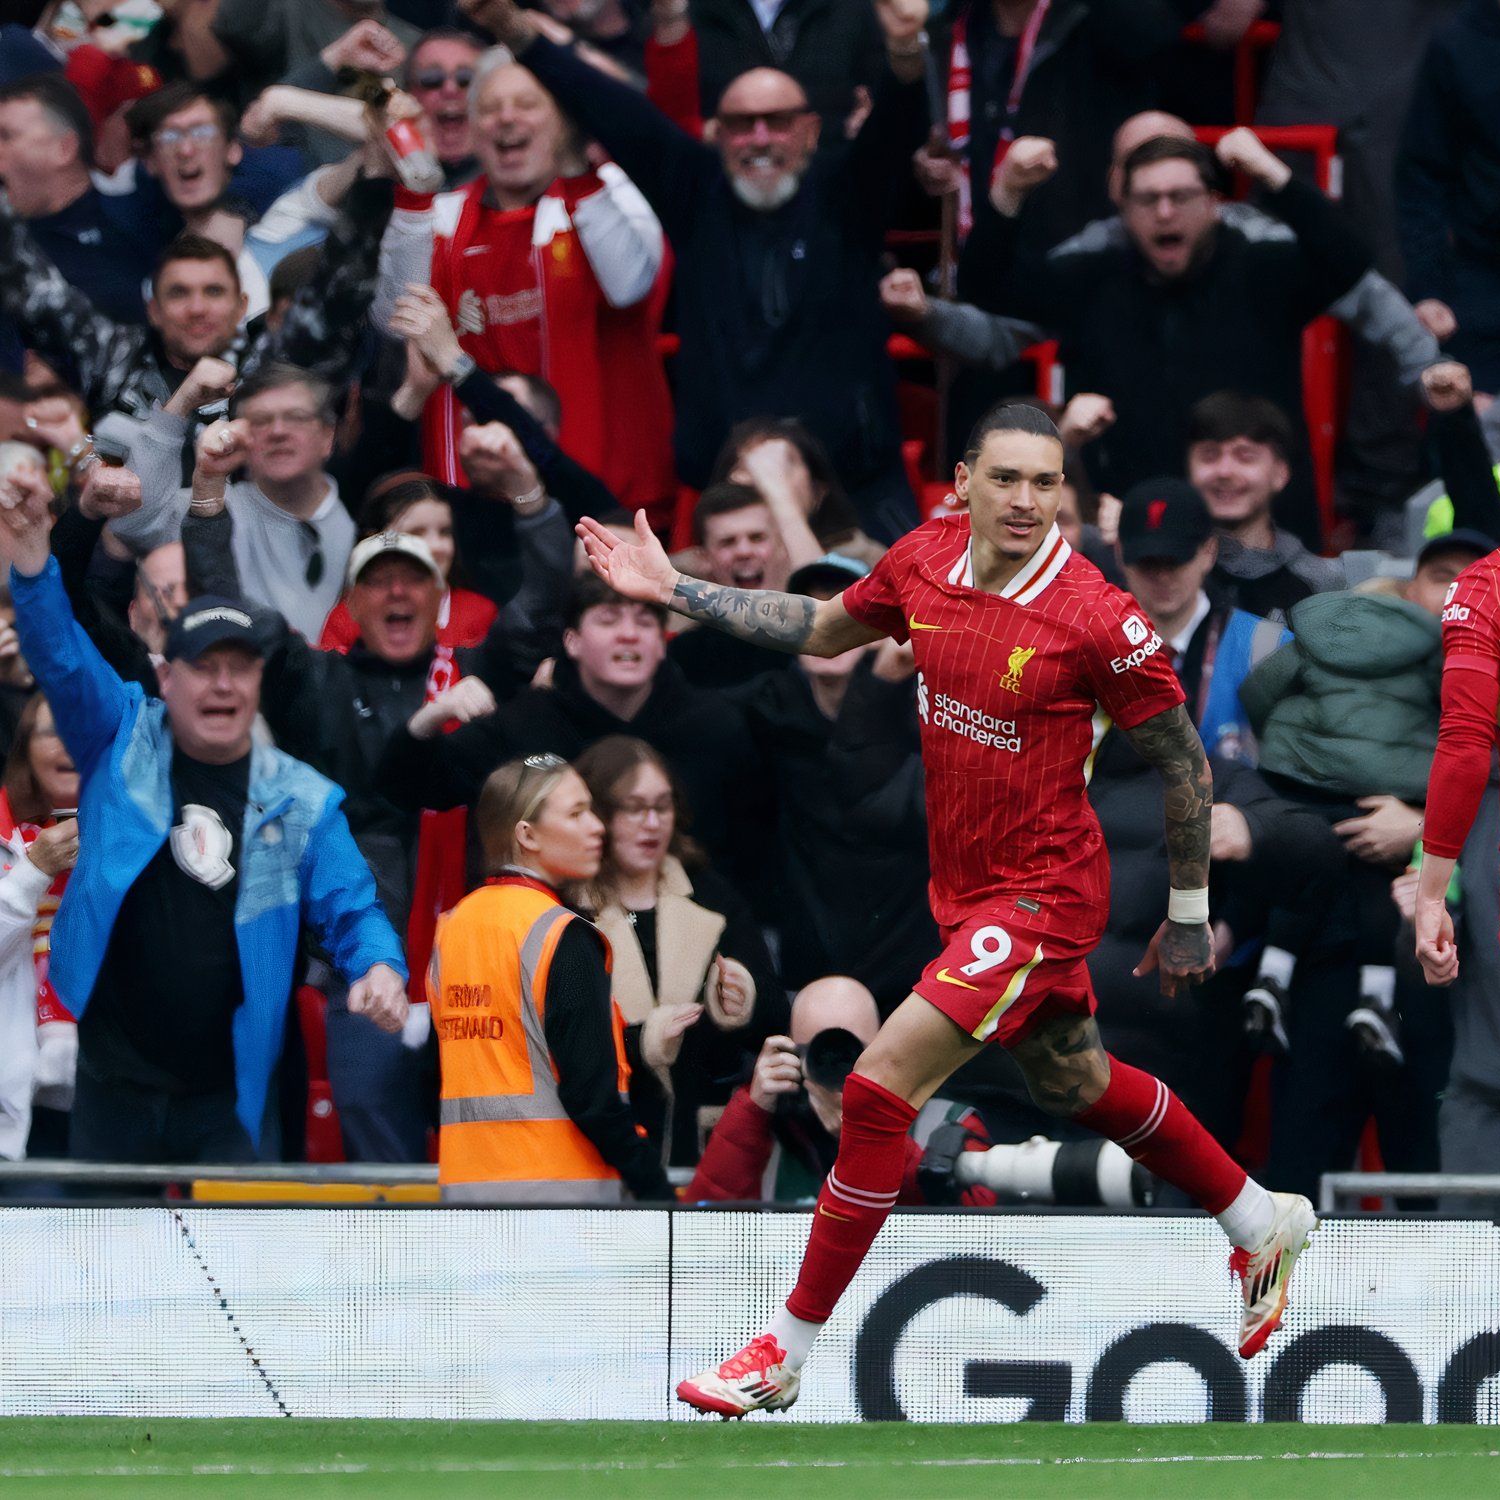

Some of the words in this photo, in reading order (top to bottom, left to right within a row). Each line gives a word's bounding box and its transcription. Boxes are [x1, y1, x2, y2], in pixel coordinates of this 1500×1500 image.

[999, 675, 1021, 694] LFC
[933, 709, 1022, 754] chartered
[934, 693, 1016, 736] standard
[959, 925, 1012, 977] 9
